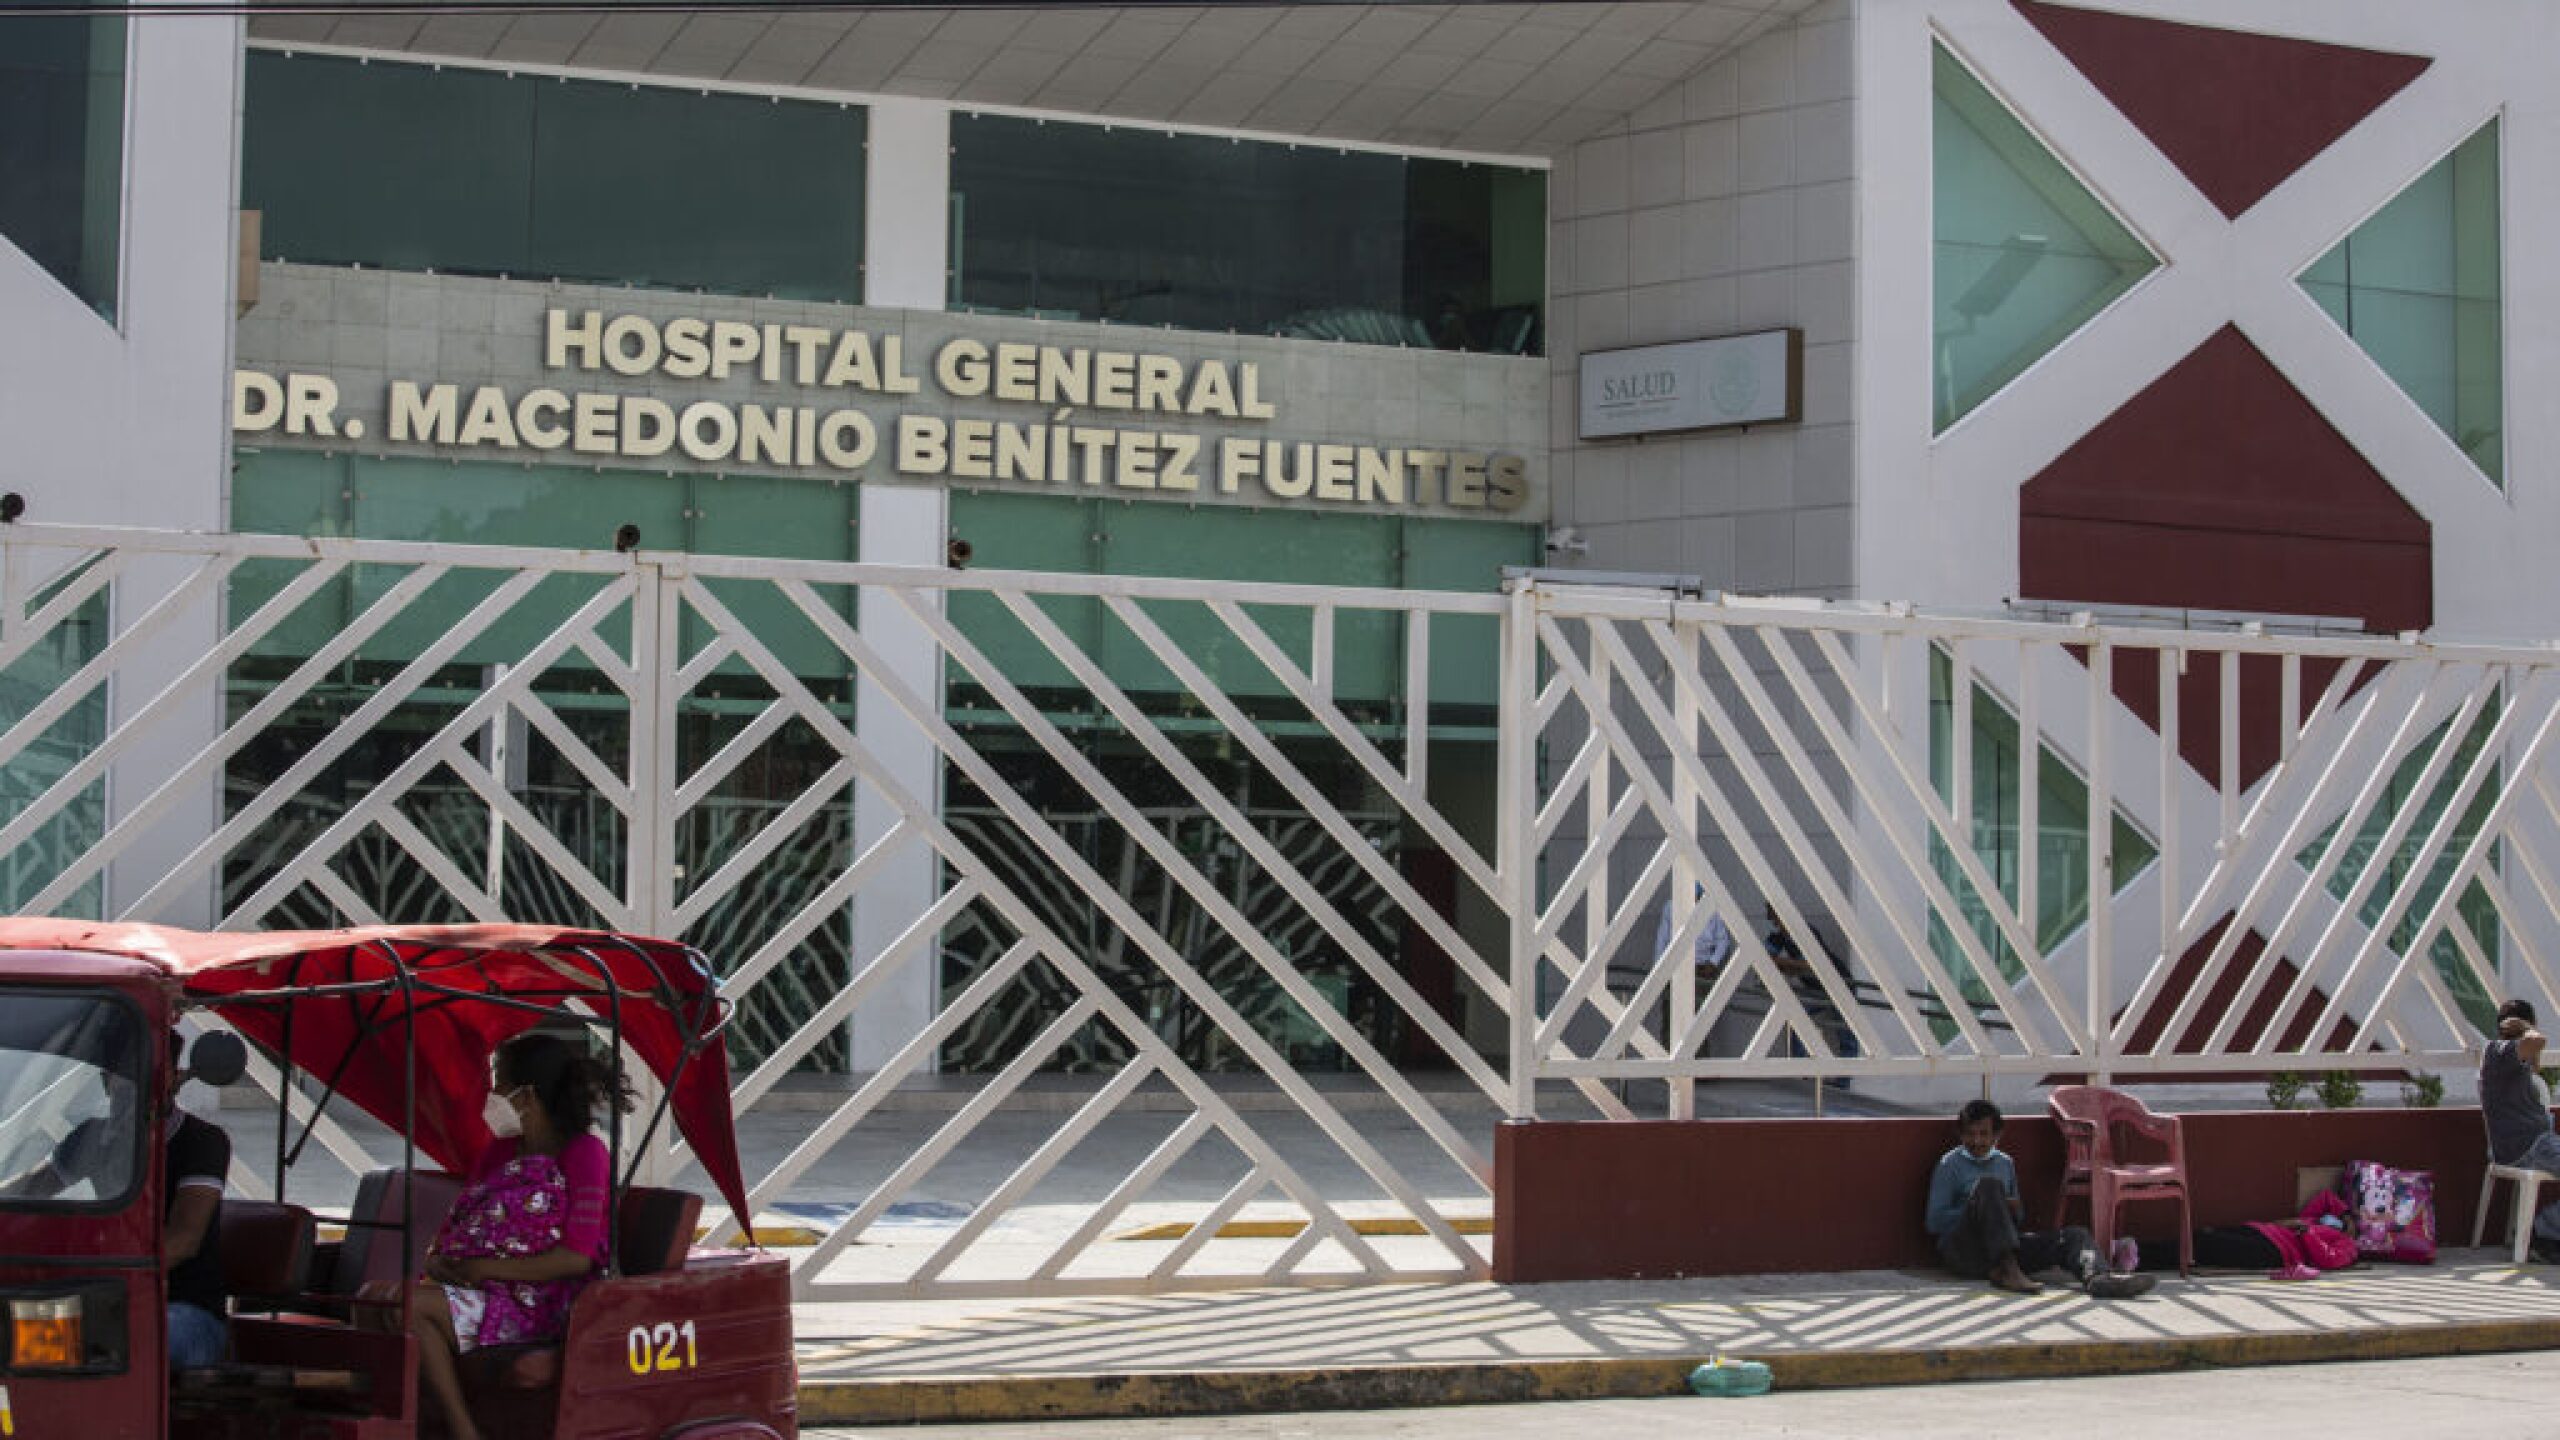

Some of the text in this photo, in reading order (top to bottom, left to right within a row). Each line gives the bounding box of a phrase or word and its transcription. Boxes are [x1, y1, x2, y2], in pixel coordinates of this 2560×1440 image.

[545, 308, 1275, 420] HOSPITAL GENERAL
[1603, 370, 1676, 401] SALUD
[233, 369, 1529, 513] DR. MACEDONIO BENÍTEZ FUENTES
[628, 1320, 698, 1375] 021
